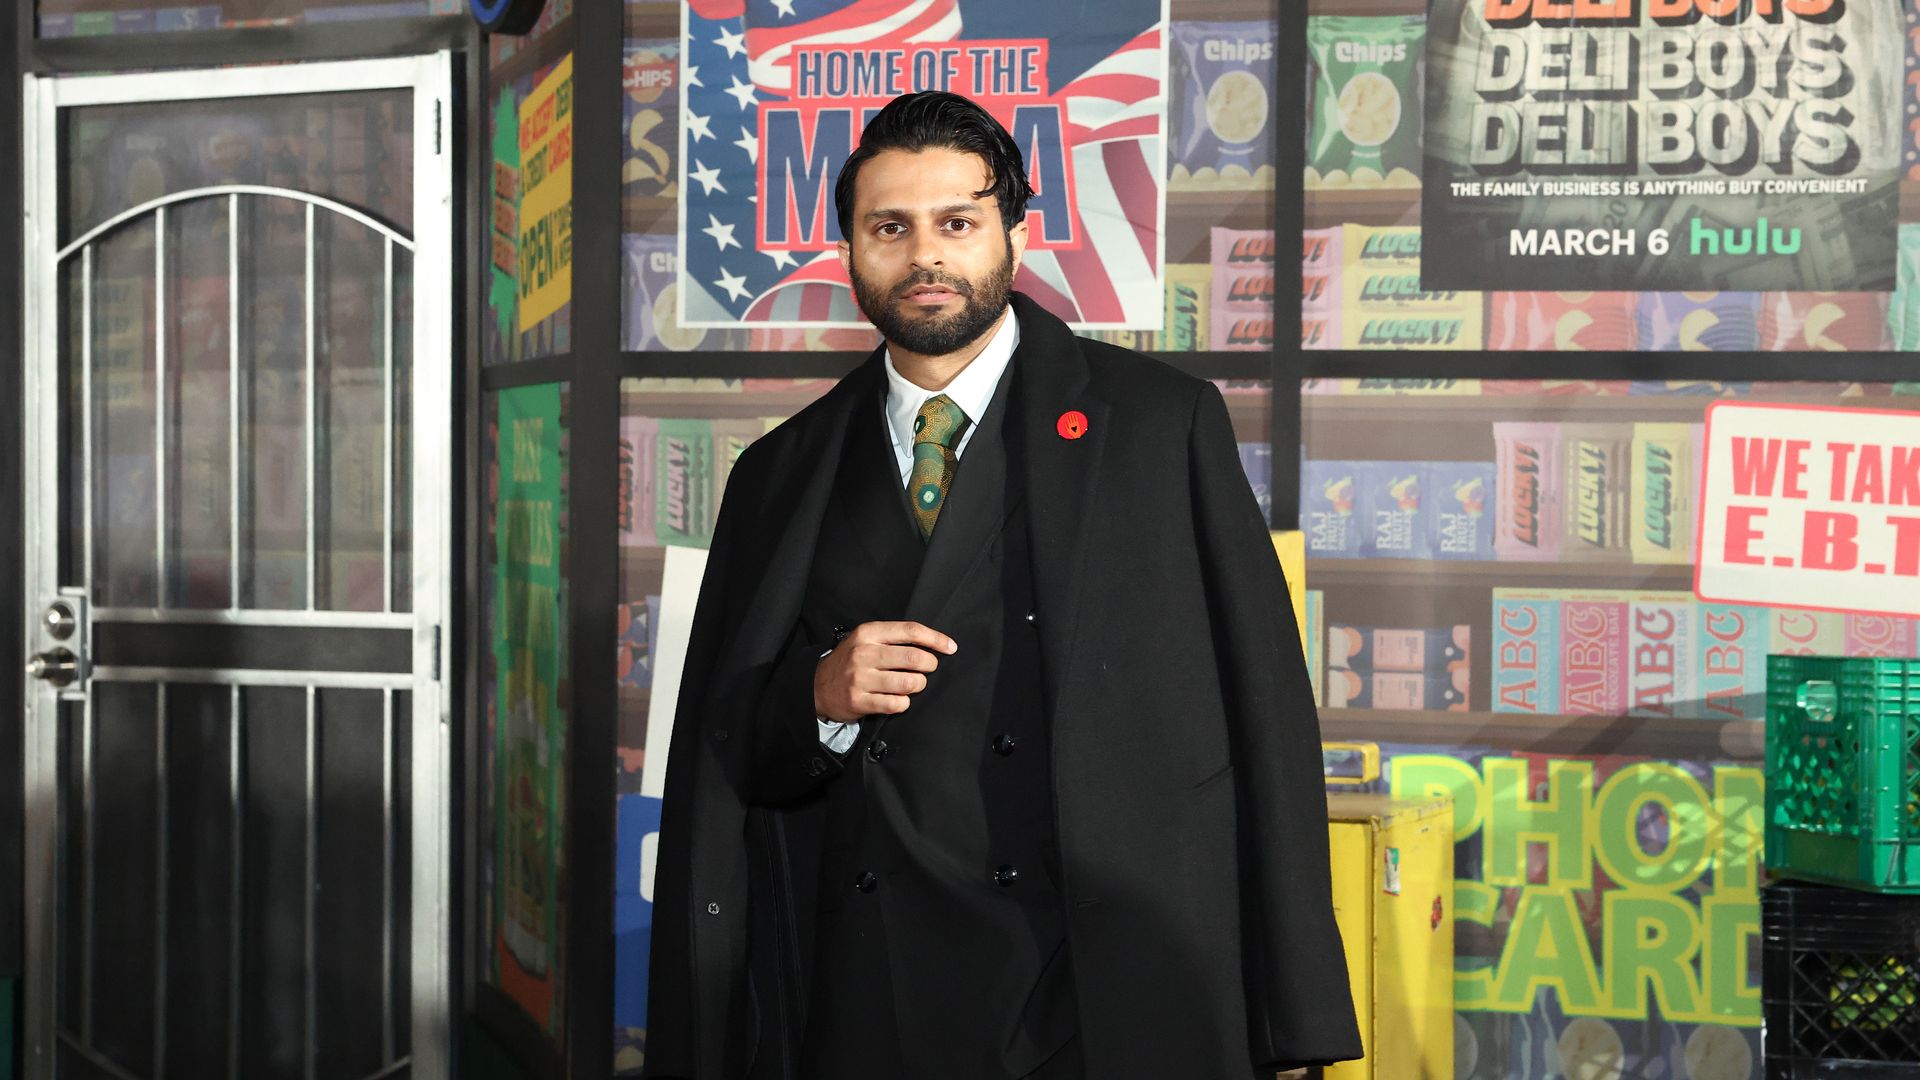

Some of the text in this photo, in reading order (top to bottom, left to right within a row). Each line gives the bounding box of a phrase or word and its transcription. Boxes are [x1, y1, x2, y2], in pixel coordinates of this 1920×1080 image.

[797, 46, 1041, 98] HOME OF THE
[1203, 39, 1274, 64] Chips
[1334, 41, 1407, 66] Chips
[1474, 28, 1855, 100] DELI BOYS
[1469, 99, 1860, 175] DELI BOYS
[1450, 179, 1868, 197] THE FAMILY BUSINESS IS ANYTHING BUT CONVENIENT
[519, 210, 553, 300] OPEN
[1360, 232, 1421, 260] LUC
[1509, 228, 1670, 256] MARCH 6
[1690, 216, 1802, 256] hulu
[1358, 318, 1465, 346] LUCKY!
[667, 436, 690, 536] LUCKY!
[1731, 436, 1811, 499] WE
[1513, 439, 1539, 548] LUCKY!
[1577, 440, 1606, 549] LUCKY!
[1644, 441, 1673, 550] LUCKY!
[1311, 511, 1327, 550] RAJ
[1327, 512, 1337, 551] FRUIT
[1376, 510, 1391, 549] RAJ
[1391, 511, 1402, 549] FRUIT
[1440, 513, 1456, 552] RAJ
[1456, 513, 1467, 552] FRUIT
[1499, 606, 1538, 713] ABC
[1566, 605, 1608, 714] ABC
[1634, 607, 1676, 716] ABC
[1704, 608, 1745, 719] ABC
